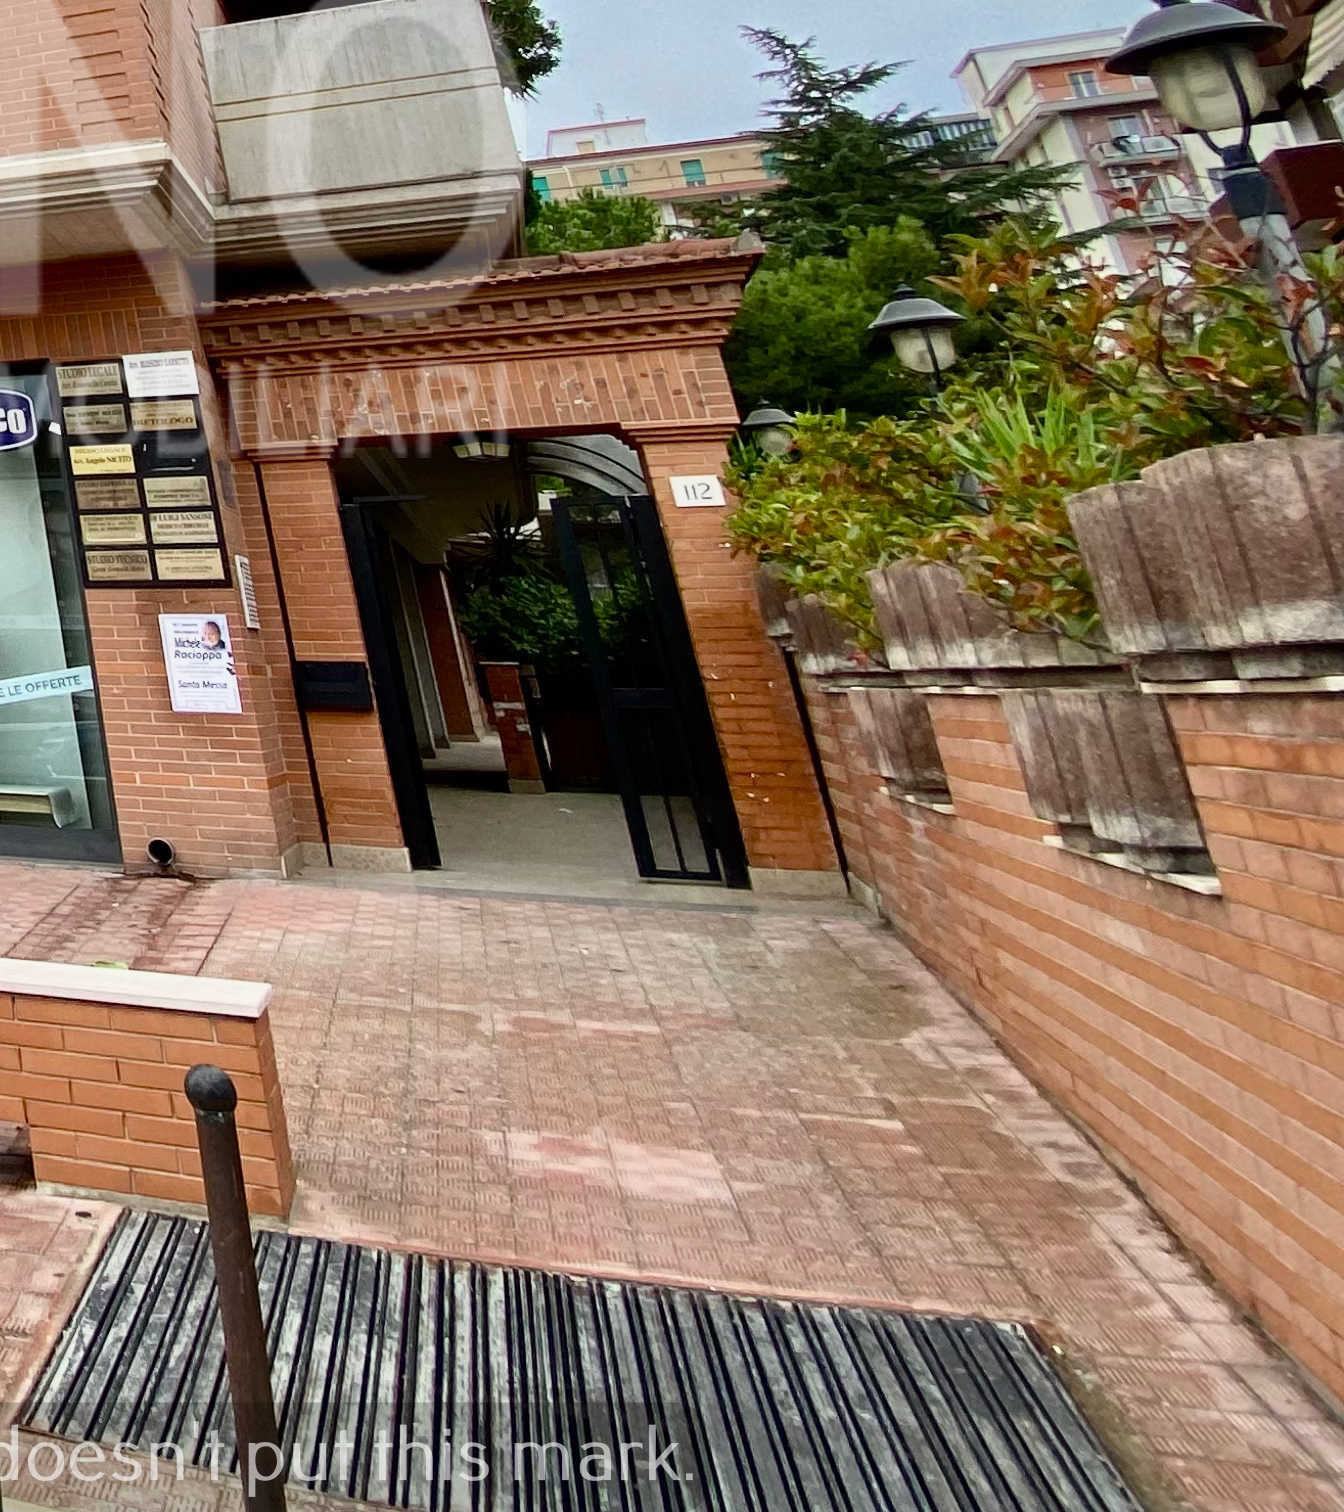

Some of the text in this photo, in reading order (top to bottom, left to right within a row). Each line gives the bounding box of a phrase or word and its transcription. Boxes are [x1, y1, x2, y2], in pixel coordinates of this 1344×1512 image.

[683, 482, 713, 501] 112
[8, 683, 23, 697] LE
[24, 674, 83, 694] OFFERTE
